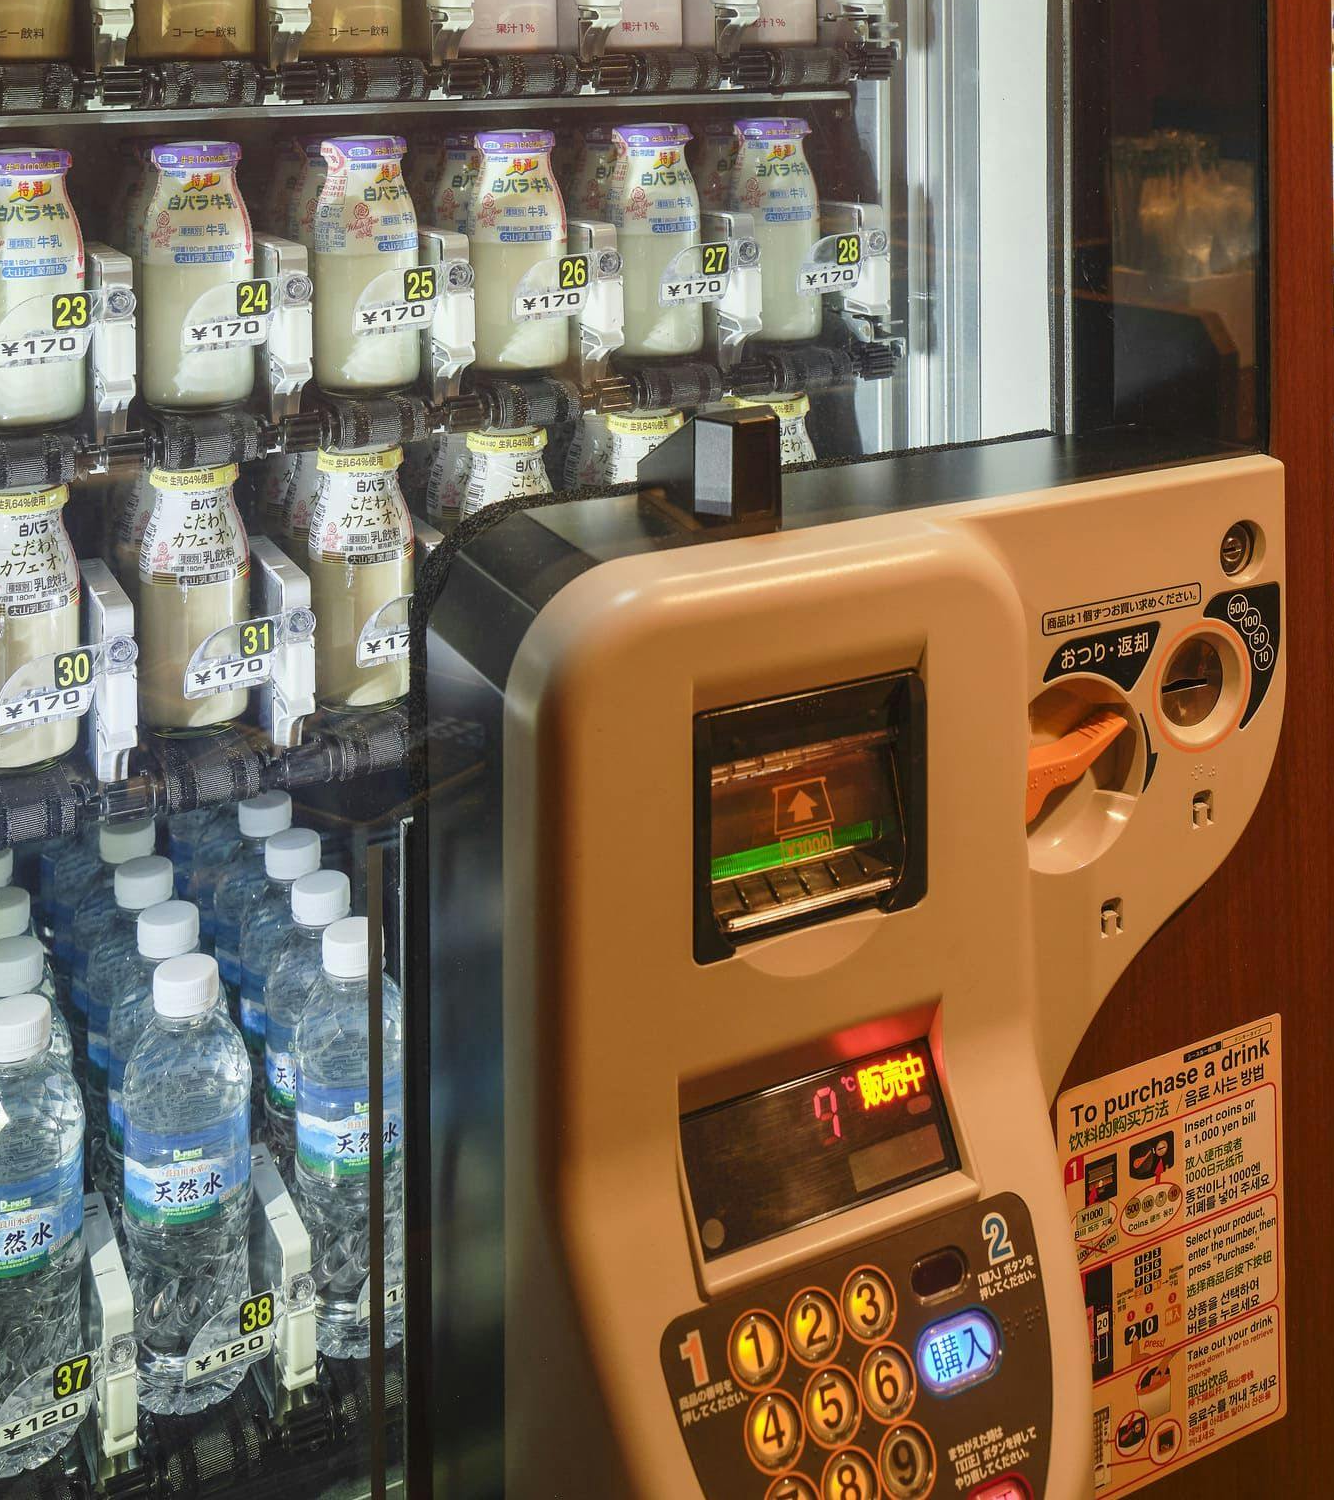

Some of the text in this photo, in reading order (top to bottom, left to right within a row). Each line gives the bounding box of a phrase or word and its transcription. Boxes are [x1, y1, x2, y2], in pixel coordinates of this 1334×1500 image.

[17, 180, 47, 197] 特選
[703, 246, 726, 273] 27
[837, 236, 859, 263] 28
[407, 269, 433, 299] 25
[562, 258, 586, 287] 26
[667, 279, 721, 297] ¥170
[806, 269, 854, 286] ¥170
[56, 295, 87, 327] 23
[240, 283, 269, 314] 24
[362, 304, 425, 325] ¥170
[523, 292, 581, 311] ¥170
[0, 336, 76, 357] ¥170
[191, 320, 260, 341] ¥170
[1047, 590, 1197, 629] 商品は1個ずつお買い求めください。
[1230, 601, 1246, 615] 500
[1243, 614, 1259, 628] 100
[243, 625, 270, 654] 31
[1061, 631, 1149, 670] おつり・返却
[1254, 633, 1265, 644] 50
[1259, 651, 1269, 662] 10
[58, 653, 90, 685] 30
[194, 658, 263, 686] ¥170
[4, 691, 80, 718] ¥170
[856, 1053, 925, 1108] 販売中
[1070, 1104, 1098, 1128] To
[1104, 1067, 1198, 1121] purchase
[1204, 1060, 1215, 1076] a
[1221, 1038, 1270, 1072] drink
[1184, 1063, 1265, 1109] 음료 사는 방법
[1068, 1098, 1169, 1152] 饮料的购买方法
[1184, 1098, 1256, 1134] Insert coins or
[1184, 1112, 1256, 1149] a 1,000 yen bill
[981, 1212, 1015, 1266] 2
[1186, 1206, 1265, 1248] Select your product,
[1188, 1217, 1276, 1262] enter the number, then
[243, 1296, 272, 1332] 38
[855, 1282, 881, 1326] 3
[800, 1303, 828, 1349] 2
[1187, 1314, 1273, 1362] Take out your drink
[195, 1335, 265, 1372] ¥120
[679, 1329, 710, 1388] 1
[745, 1323, 765, 1369] 1
[929, 1326, 992, 1382] 購入
[57, 1359, 90, 1396] 37
[874, 1359, 899, 1404] 6
[3, 1401, 79, 1441] ¥120
[819, 1381, 844, 1429] 5
[762, 1403, 786, 1450] 4
[892, 1438, 917, 1485] 9
